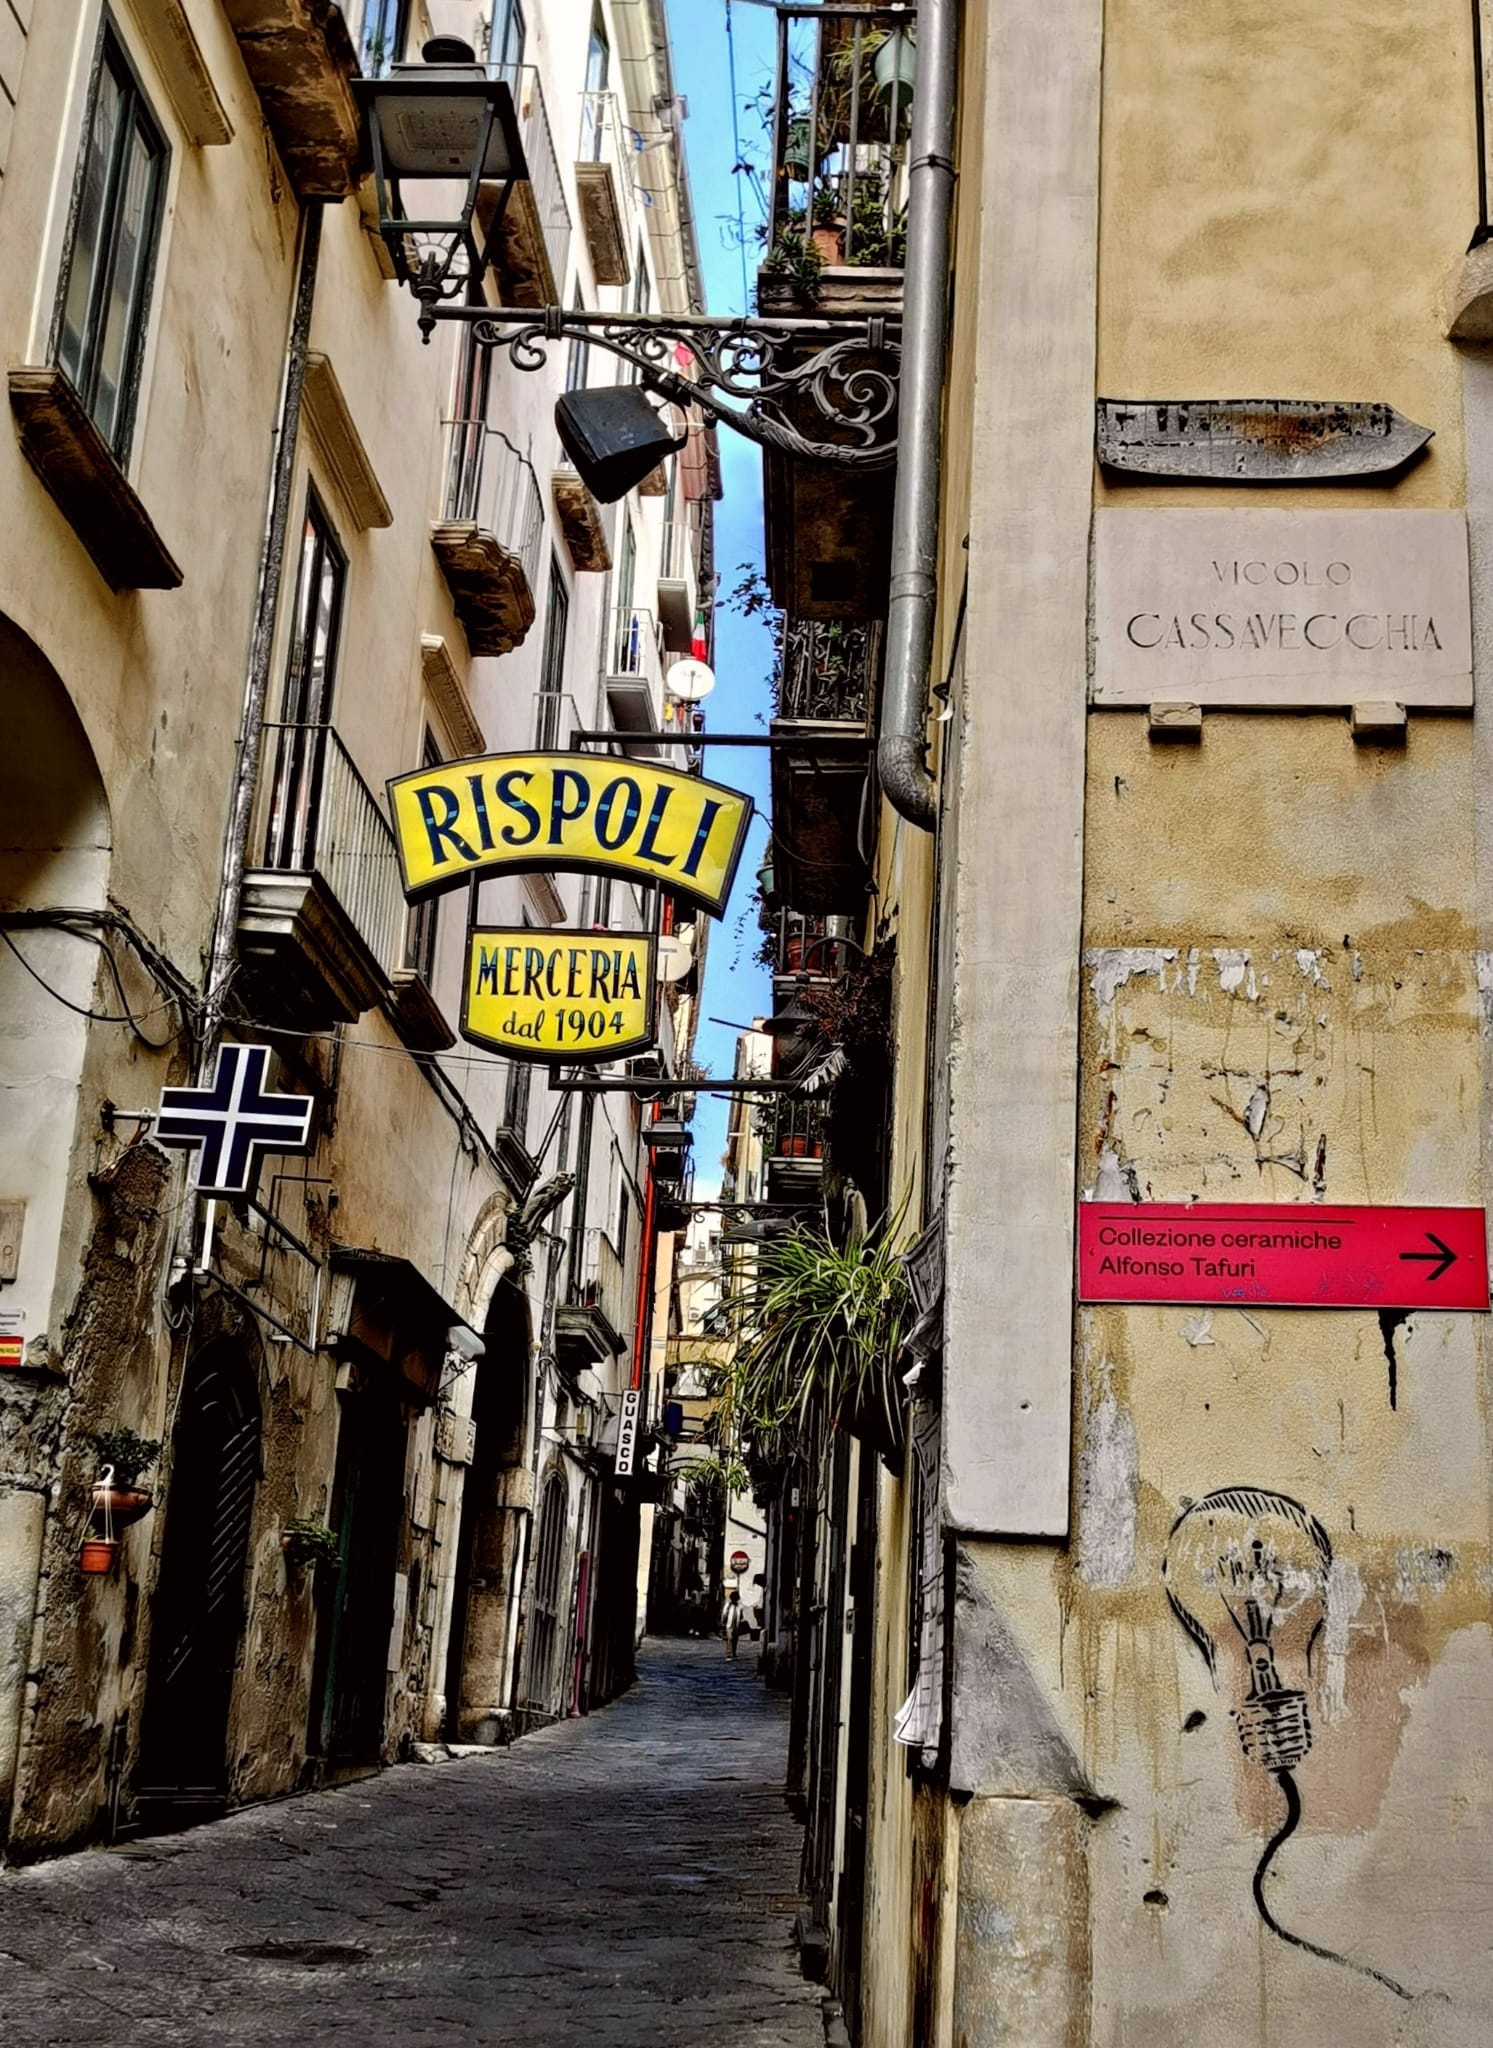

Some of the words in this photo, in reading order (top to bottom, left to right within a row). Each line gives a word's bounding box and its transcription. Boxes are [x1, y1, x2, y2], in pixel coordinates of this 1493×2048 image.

[1211, 561, 1352, 586] VICOLO
[1127, 613, 1443, 651] CASSAVECCHIA
[413, 769, 722, 879] RISPOLI
[476, 945, 642, 1003] MERCERIA
[502, 1009, 546, 1042] dal
[555, 1008, 625, 1042] 1904
[1098, 1227, 1216, 1248] Collezione
[1220, 1228, 1343, 1251] ceramiche
[1098, 1256, 1185, 1277] Alfonso
[1190, 1257, 1256, 1278] Tafuri
[618, 1392, 637, 1472] GUASCO
